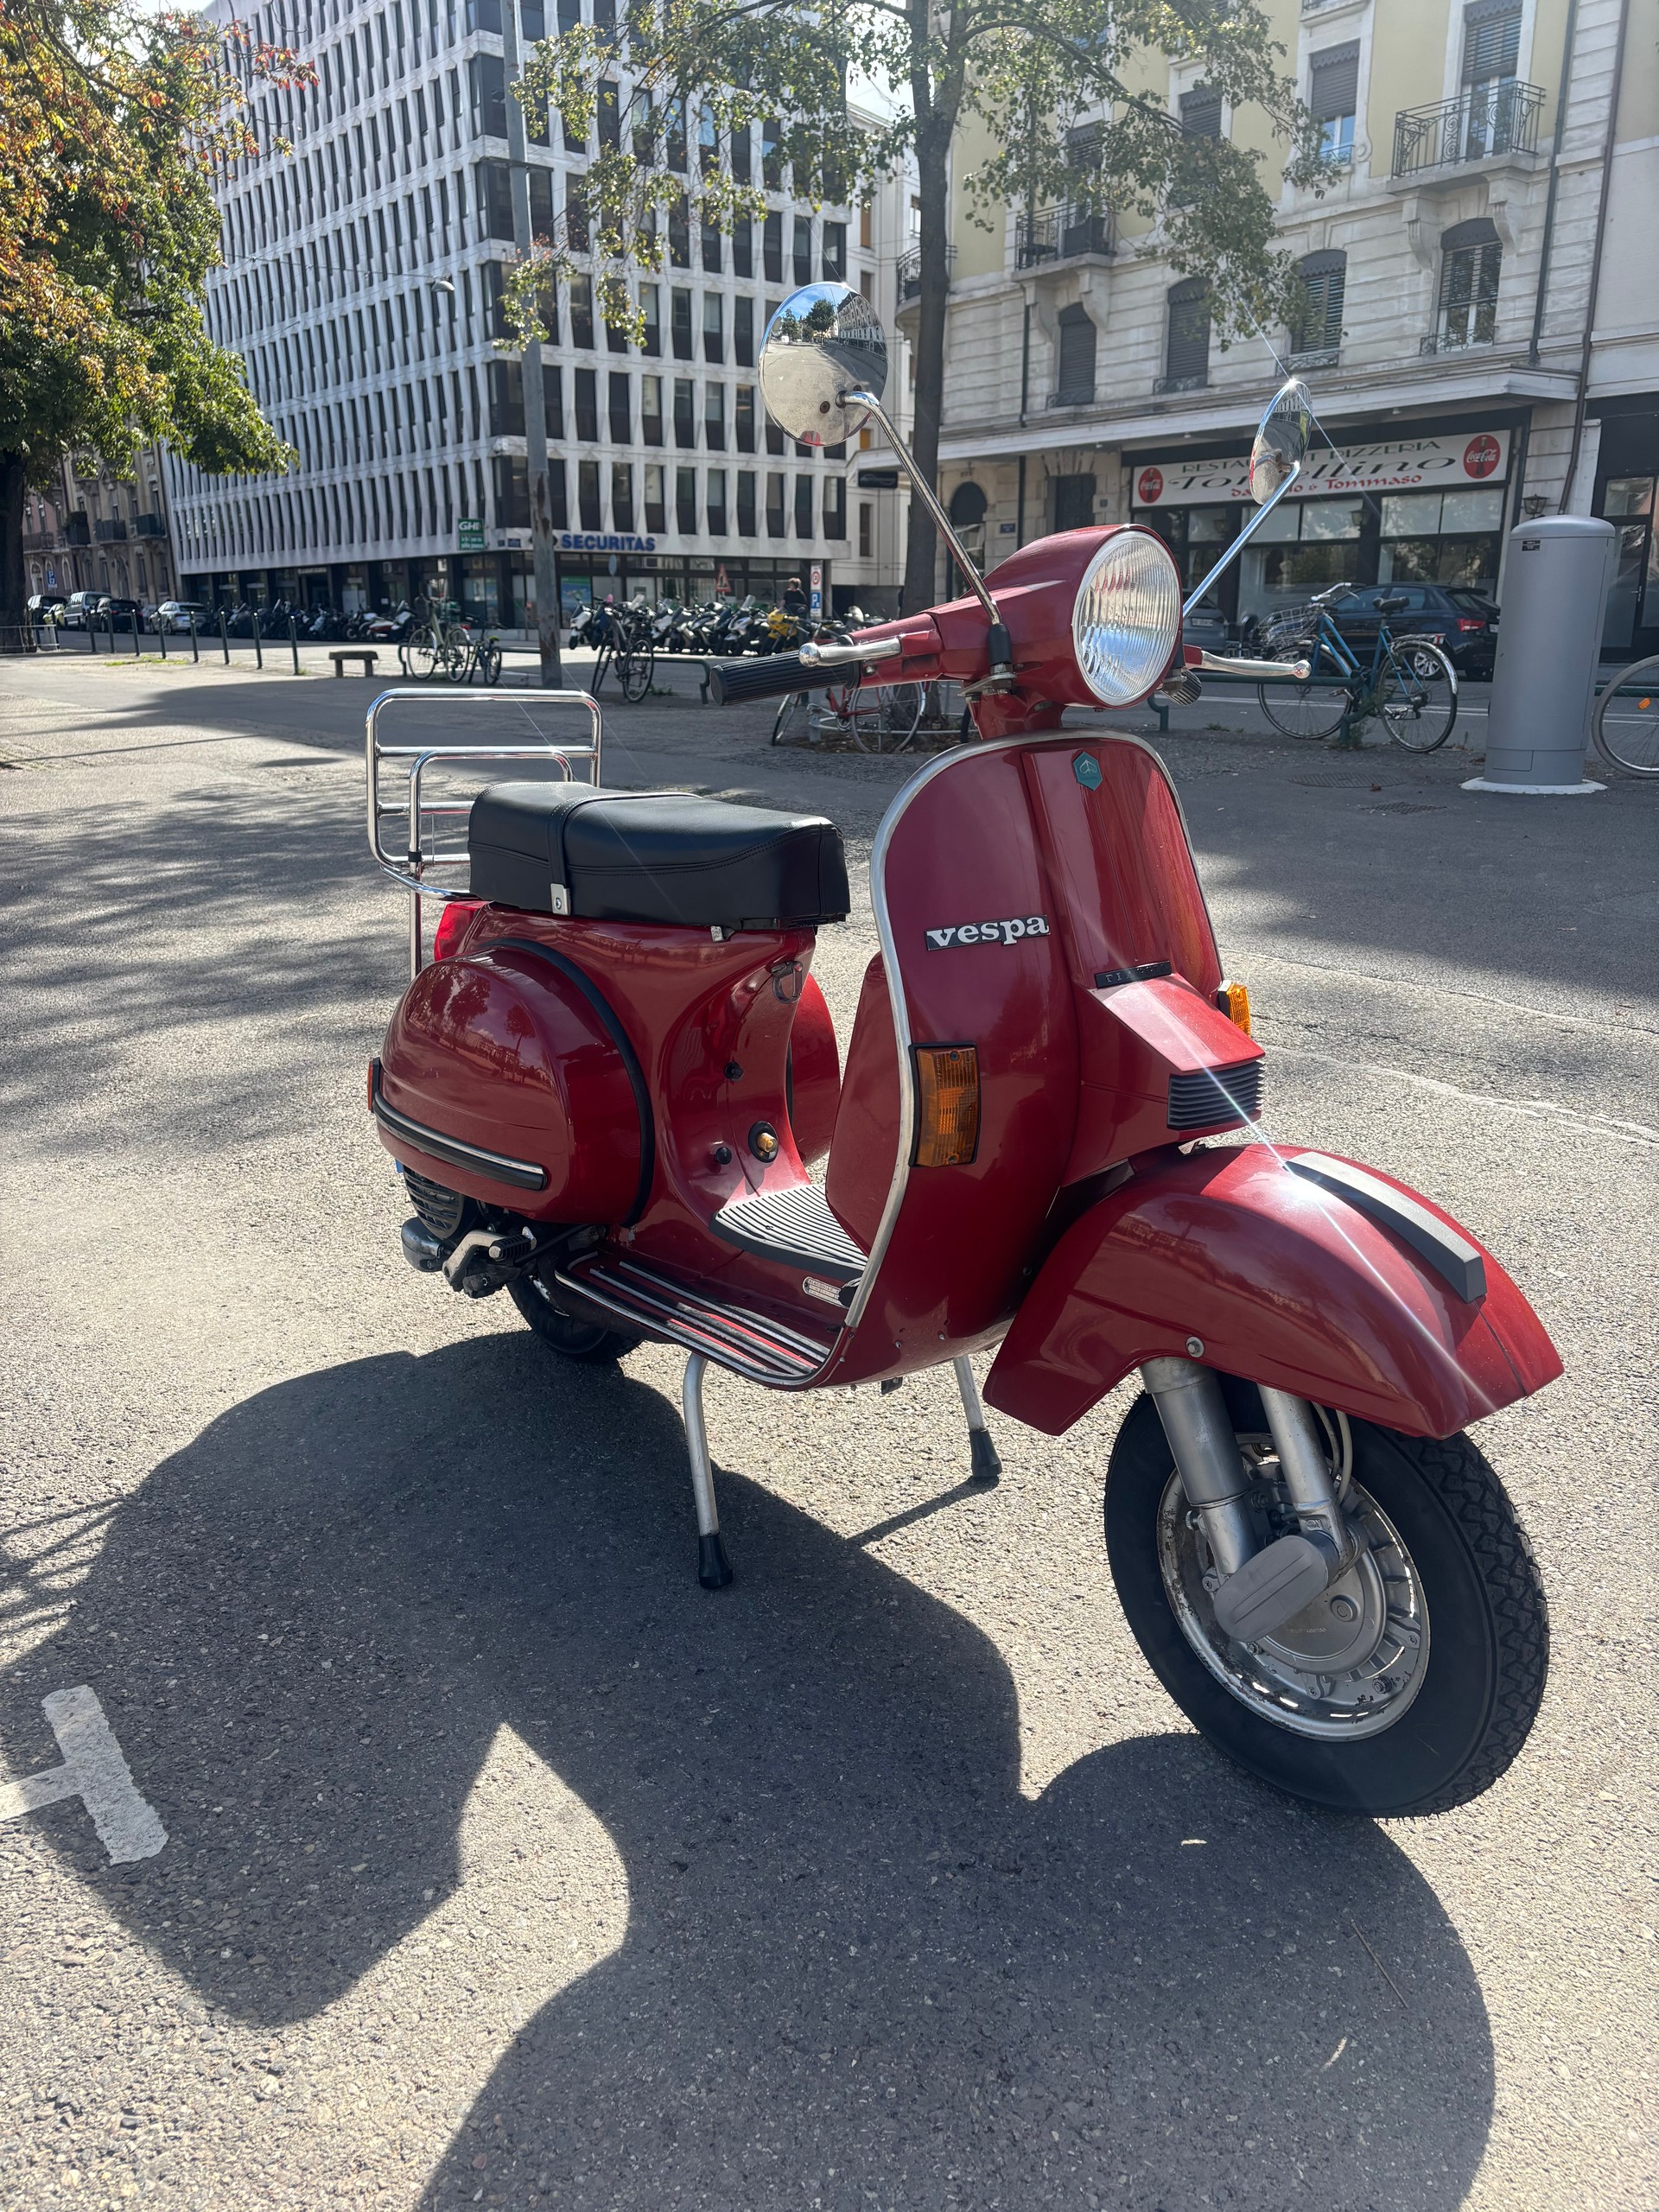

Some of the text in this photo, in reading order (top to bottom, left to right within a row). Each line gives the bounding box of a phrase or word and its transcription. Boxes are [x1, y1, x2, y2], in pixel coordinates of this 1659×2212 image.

[1182, 441, 1441, 473] RESTAT PIZZERIA
[1466, 448, 1497, 463] Coca-Cola
[1168, 457, 1456, 490] Tollino
[1325, 474, 1422, 490] Tommaso
[562, 534, 656, 551] SECURITAS
[926, 917, 1050, 945] vespa
